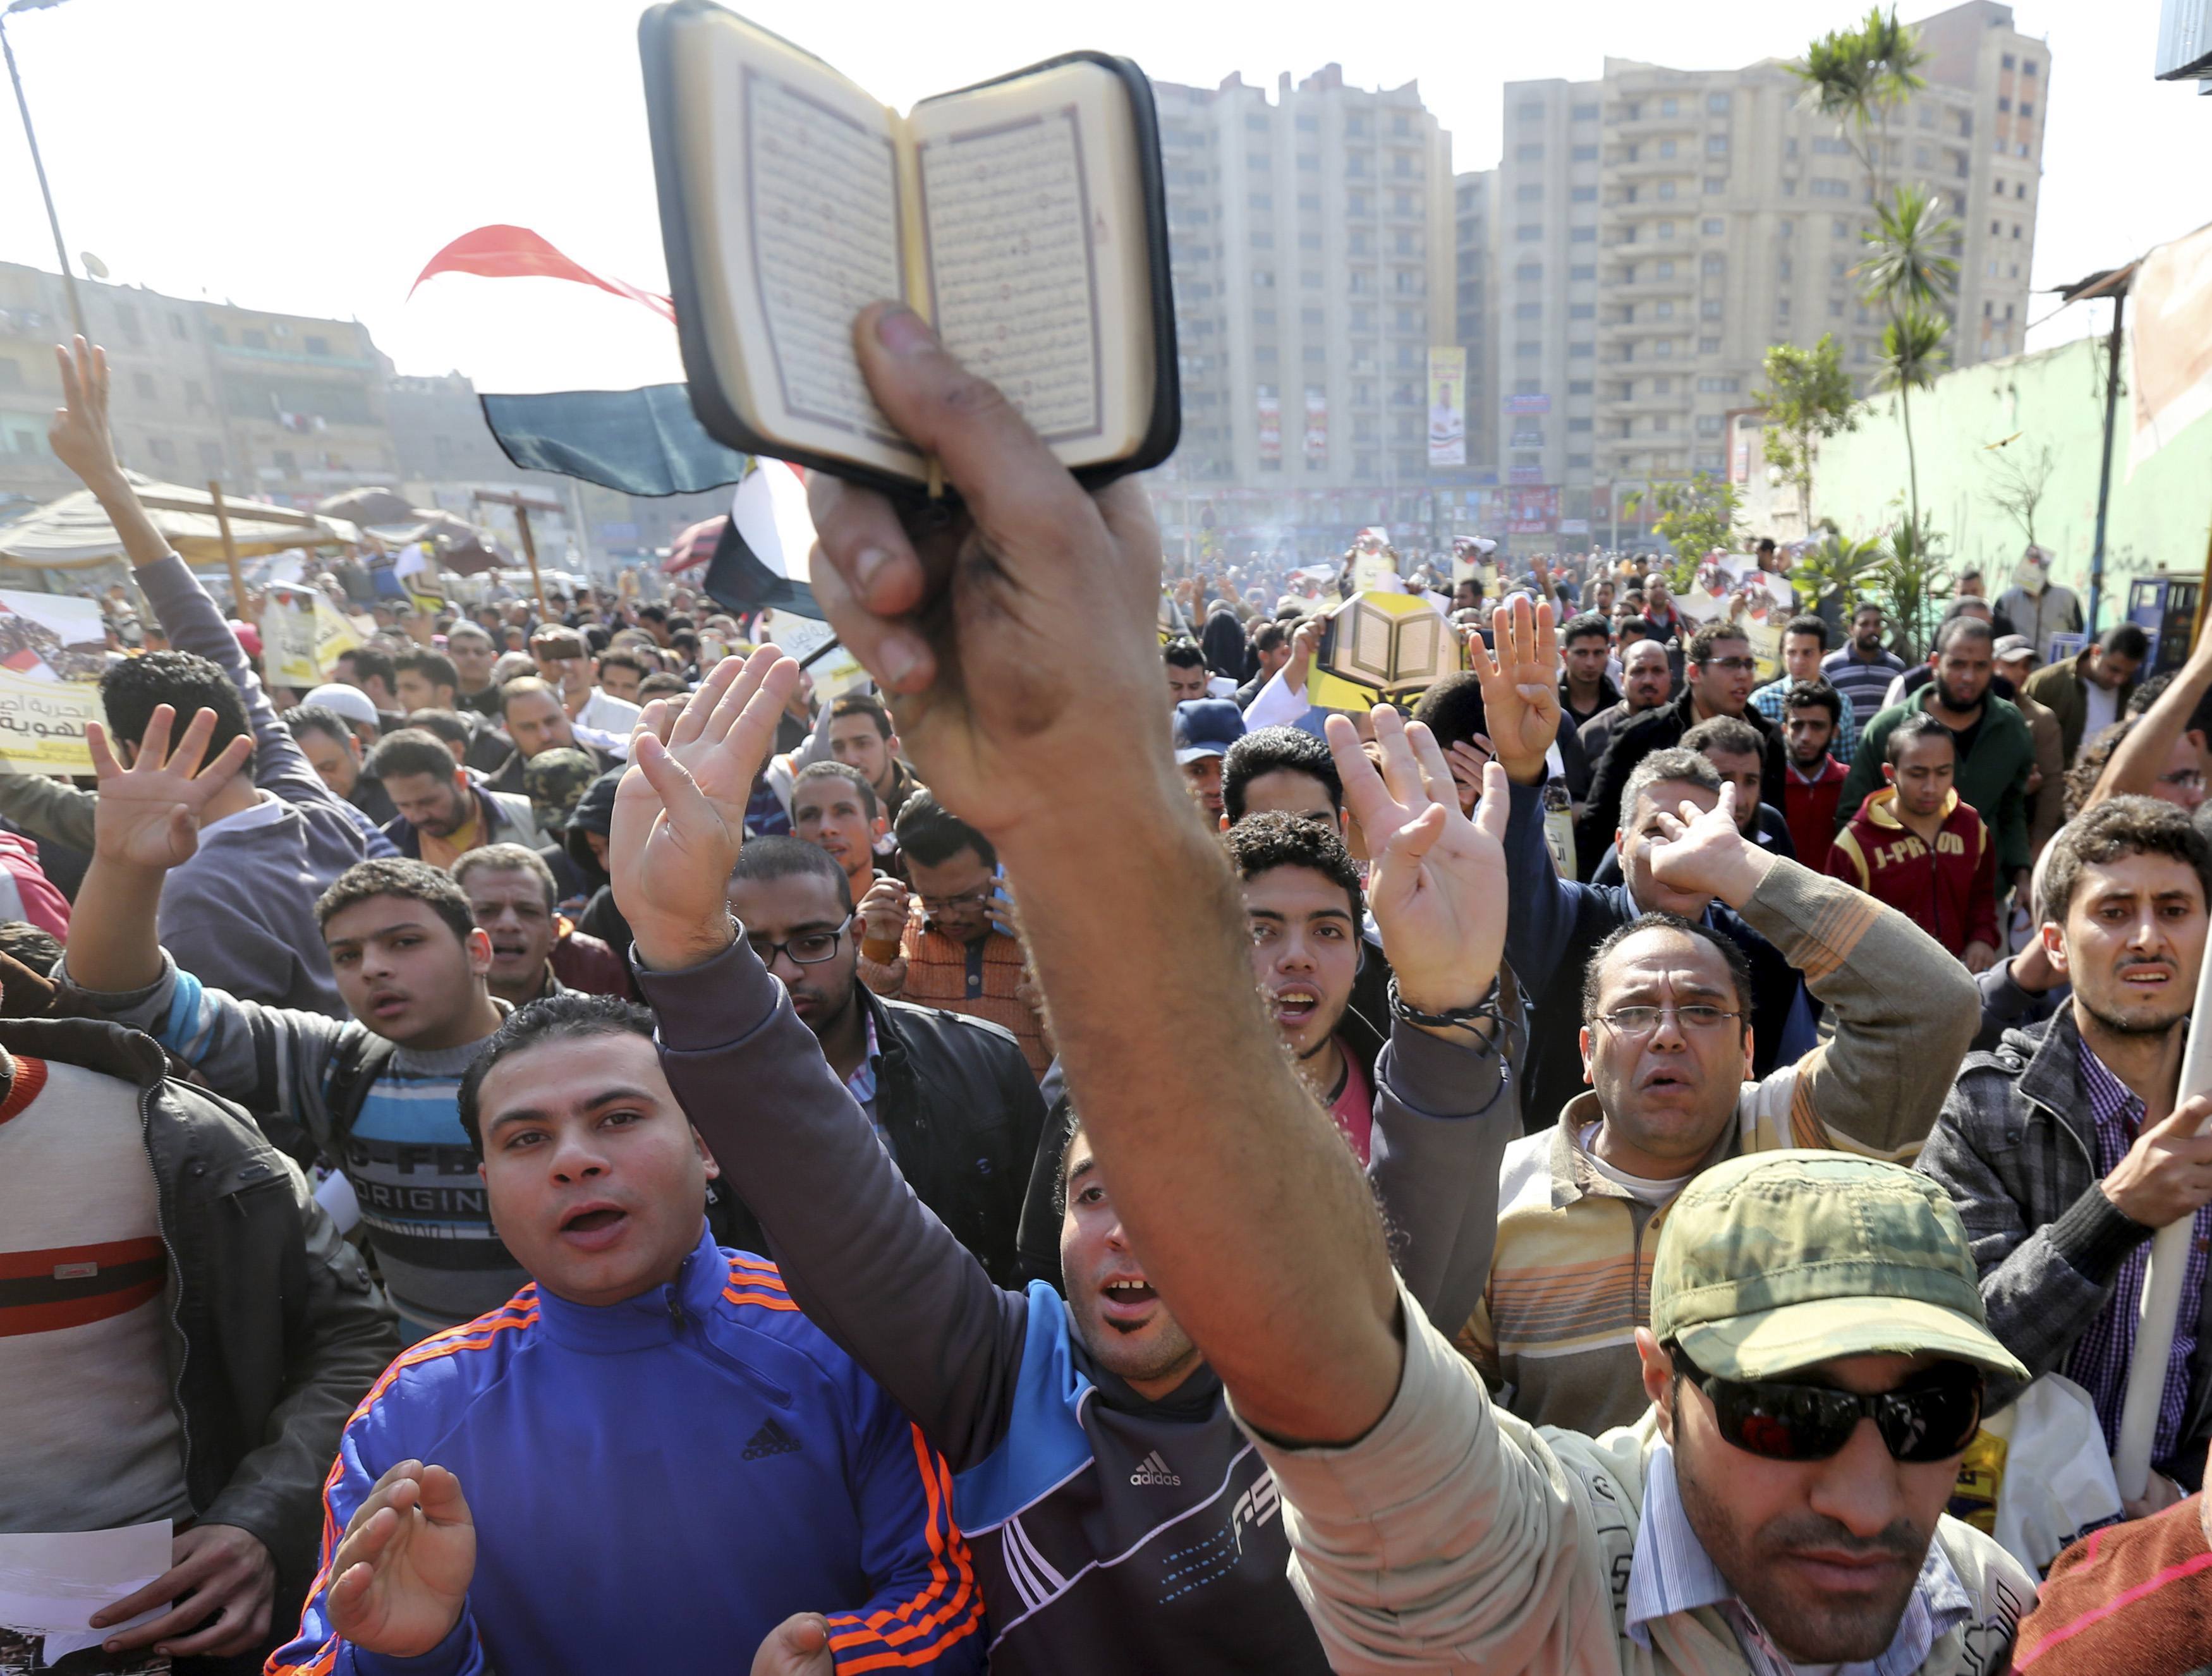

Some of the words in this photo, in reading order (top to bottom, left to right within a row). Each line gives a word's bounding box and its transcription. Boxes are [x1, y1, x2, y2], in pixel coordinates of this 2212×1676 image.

[0, 709, 87, 738] لهوية
[1874, 831, 1965, 870] J-PROD
[1130, 1471, 1181, 1486] adidas
